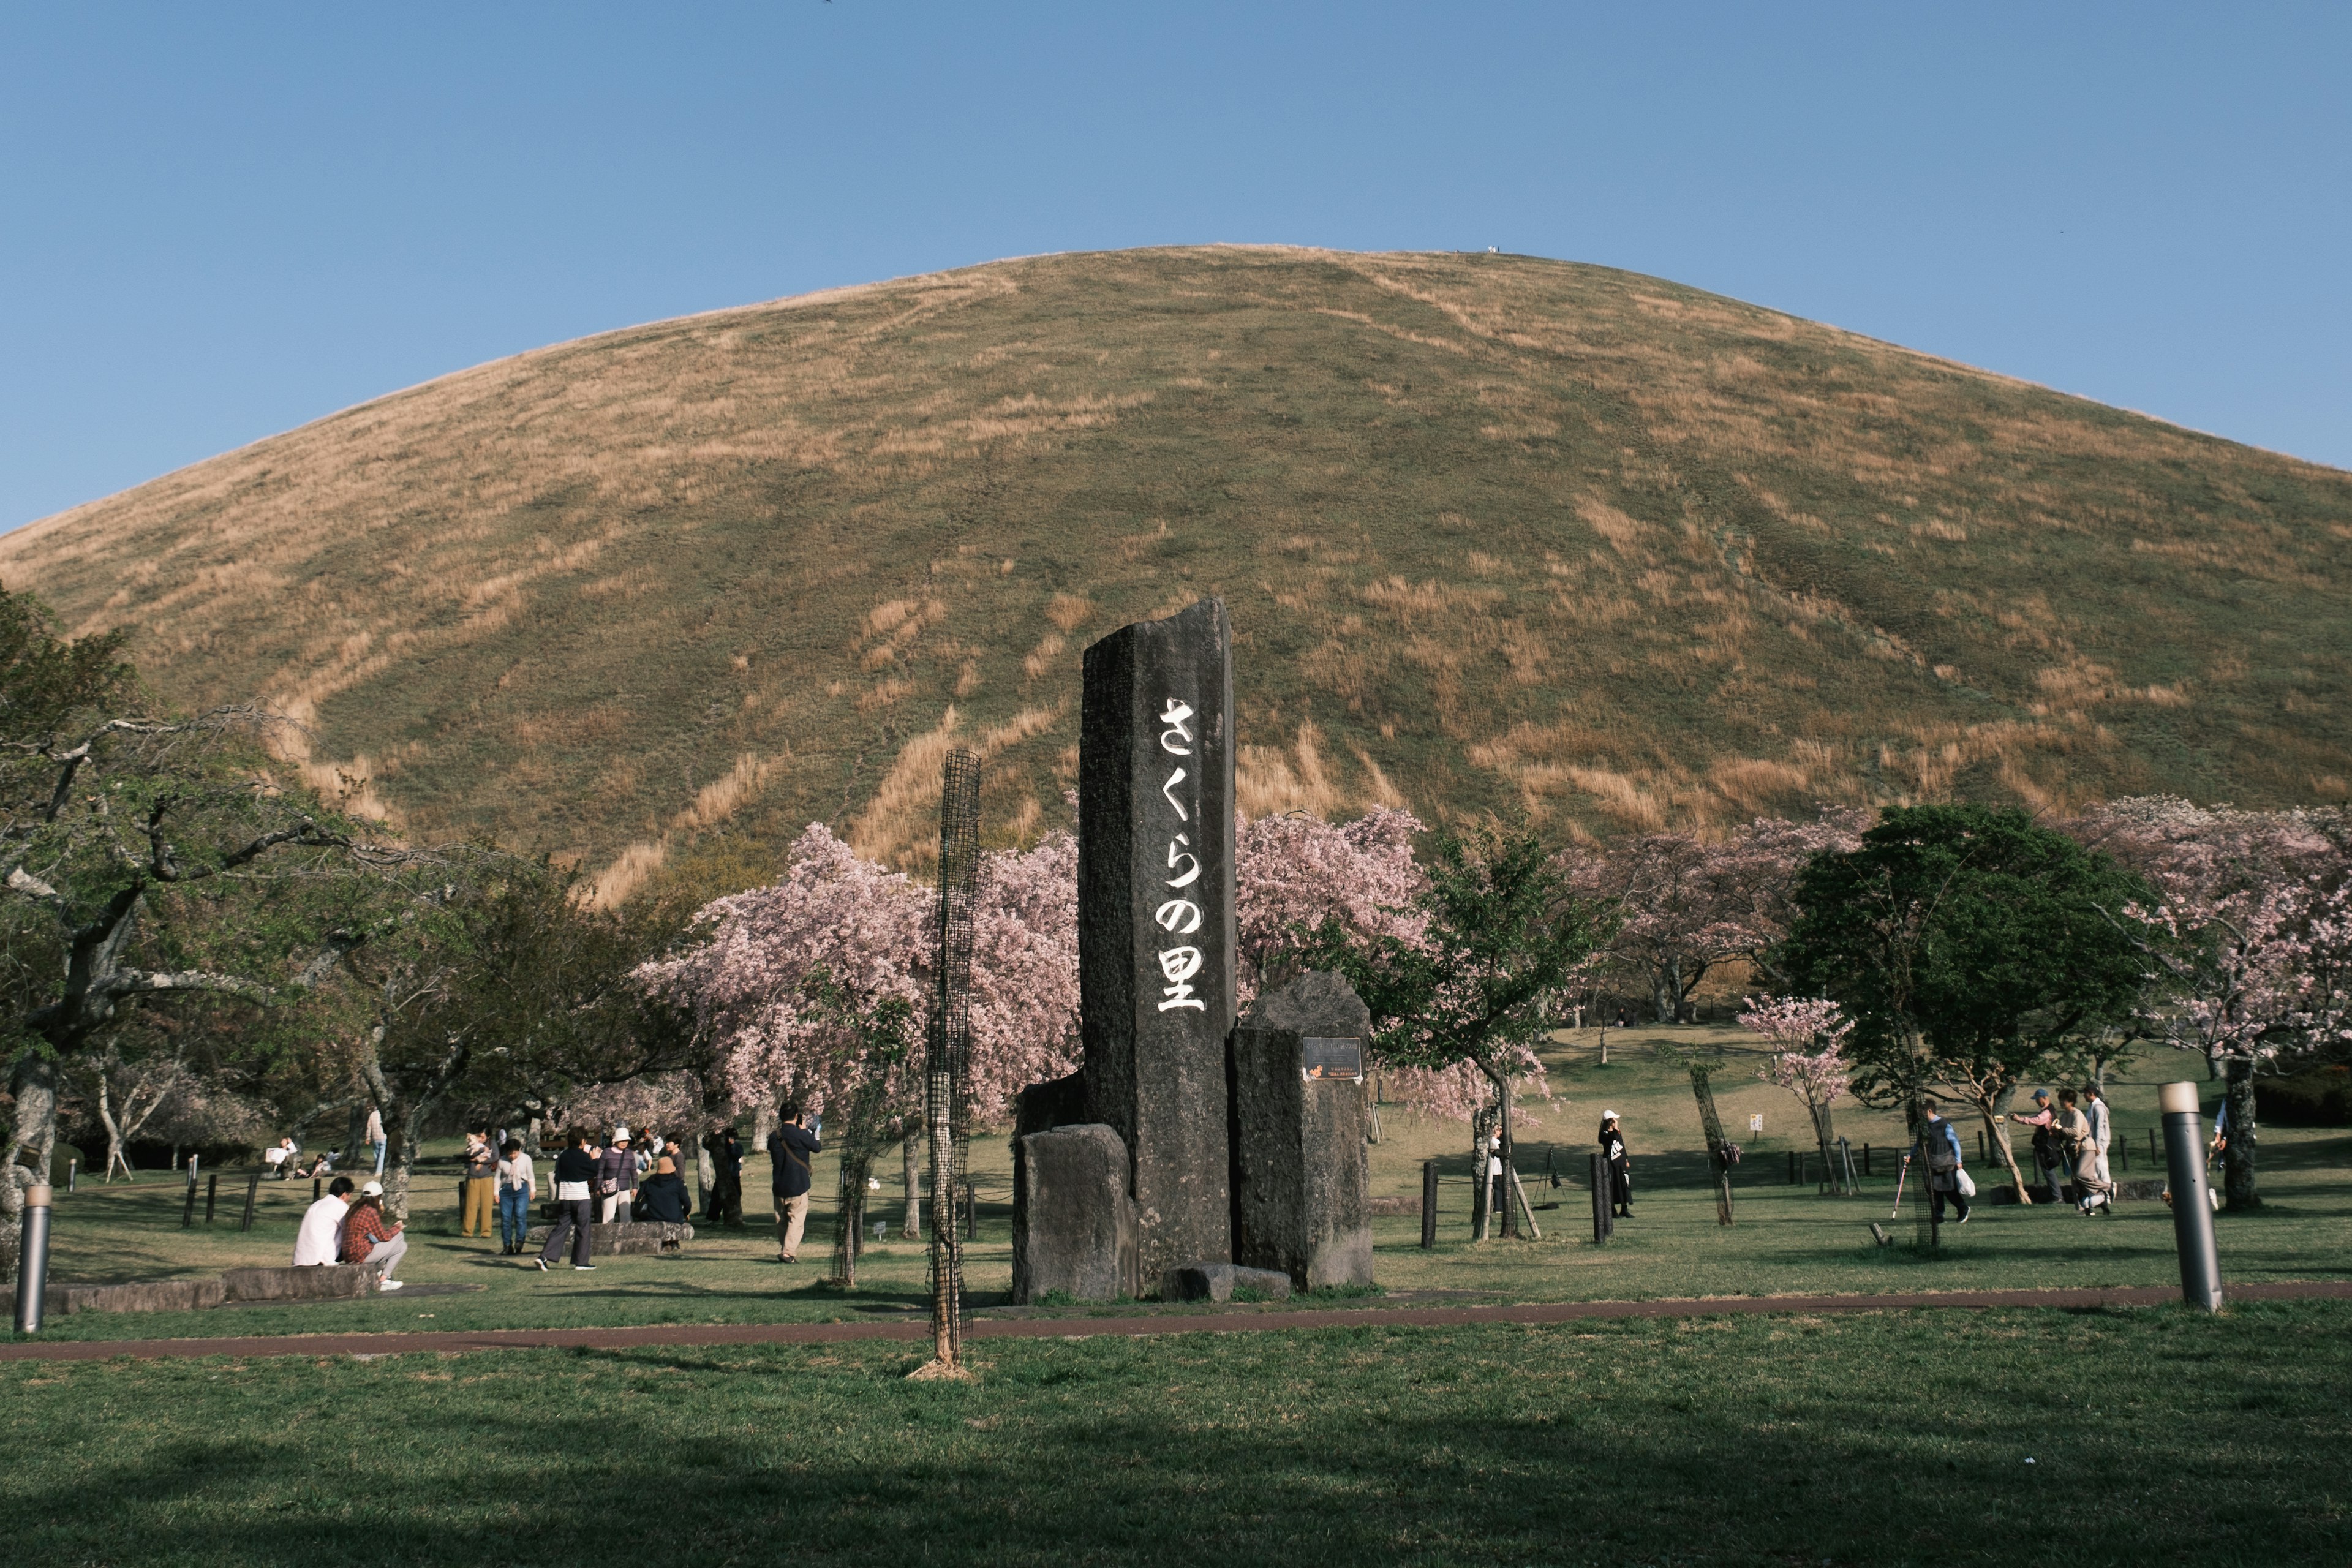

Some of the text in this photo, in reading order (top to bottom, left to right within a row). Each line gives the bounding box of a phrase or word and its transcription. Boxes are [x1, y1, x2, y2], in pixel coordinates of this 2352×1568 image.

[1155, 697, 1206, 1011] さくらの里
